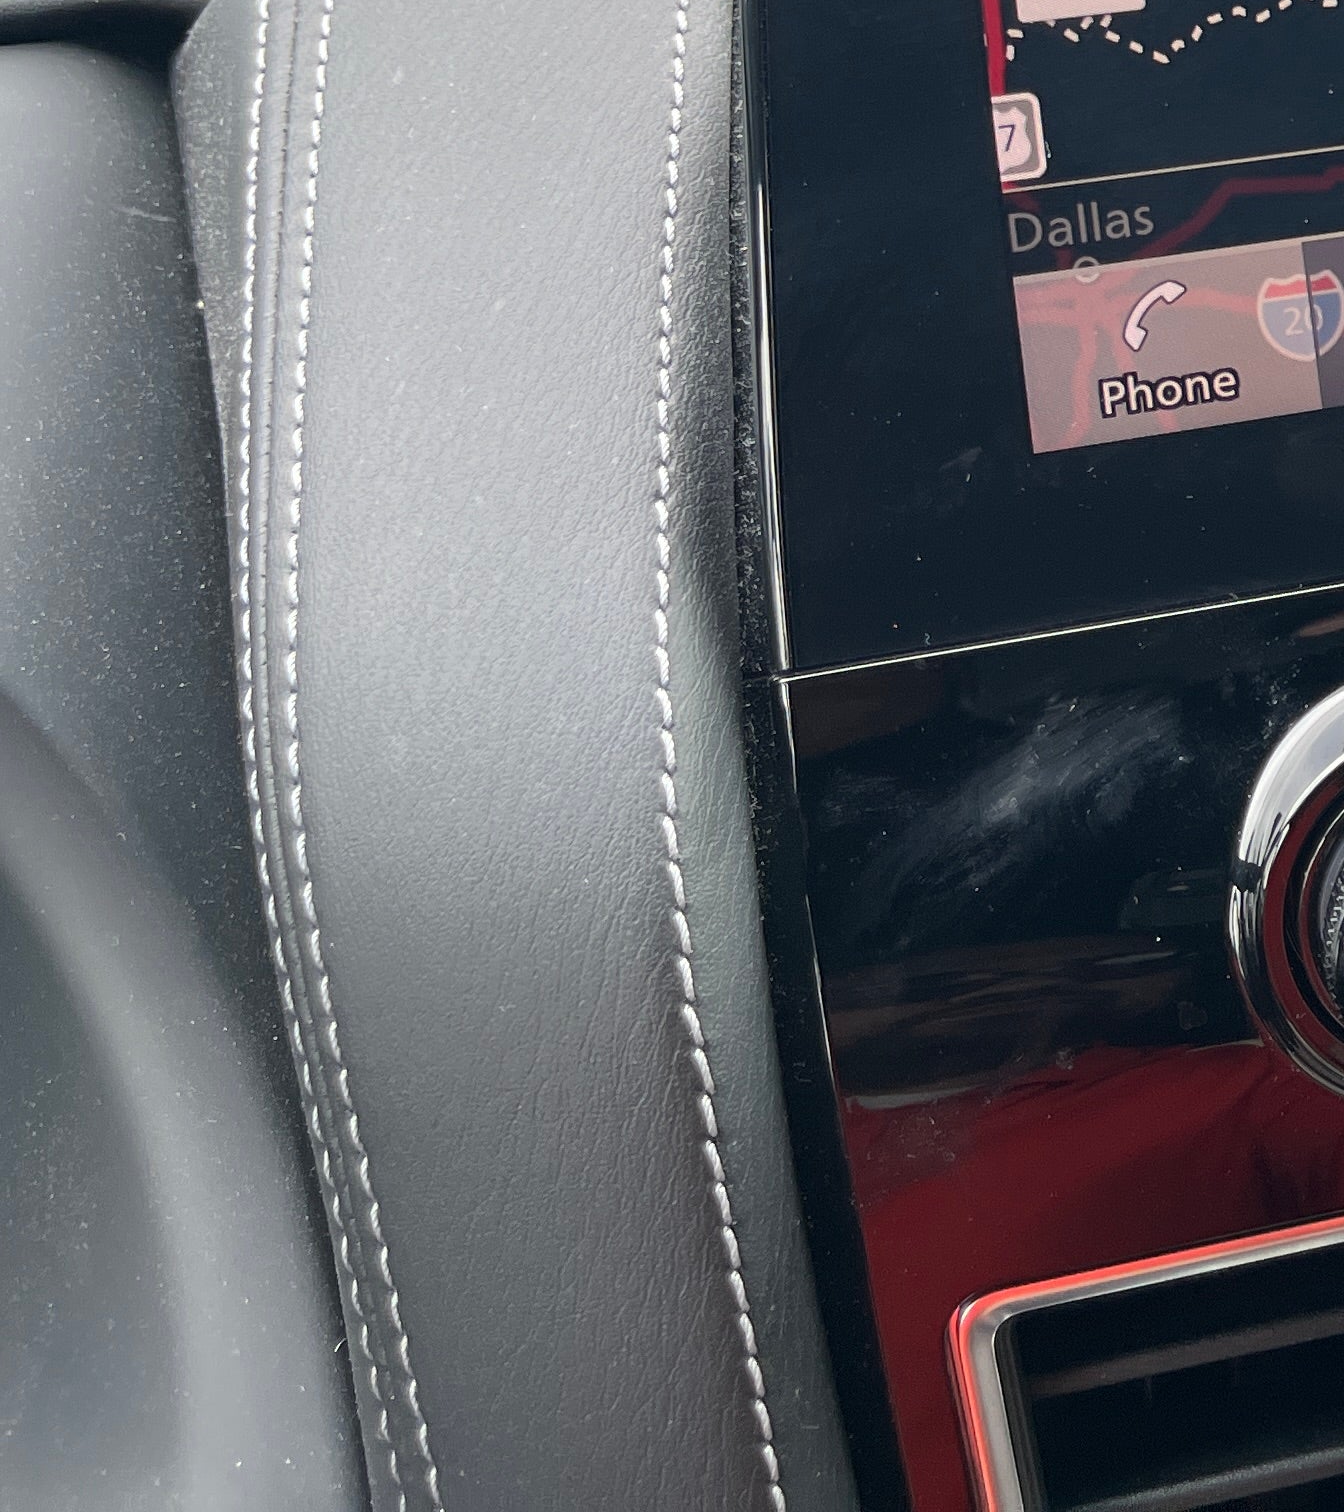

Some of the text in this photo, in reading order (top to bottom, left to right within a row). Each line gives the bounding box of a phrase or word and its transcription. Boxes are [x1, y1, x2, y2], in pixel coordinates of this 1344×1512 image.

[1008, 202, 1155, 255] Dallas
[1282, 305, 1324, 339] 20
[1099, 366, 1241, 420] Phone
